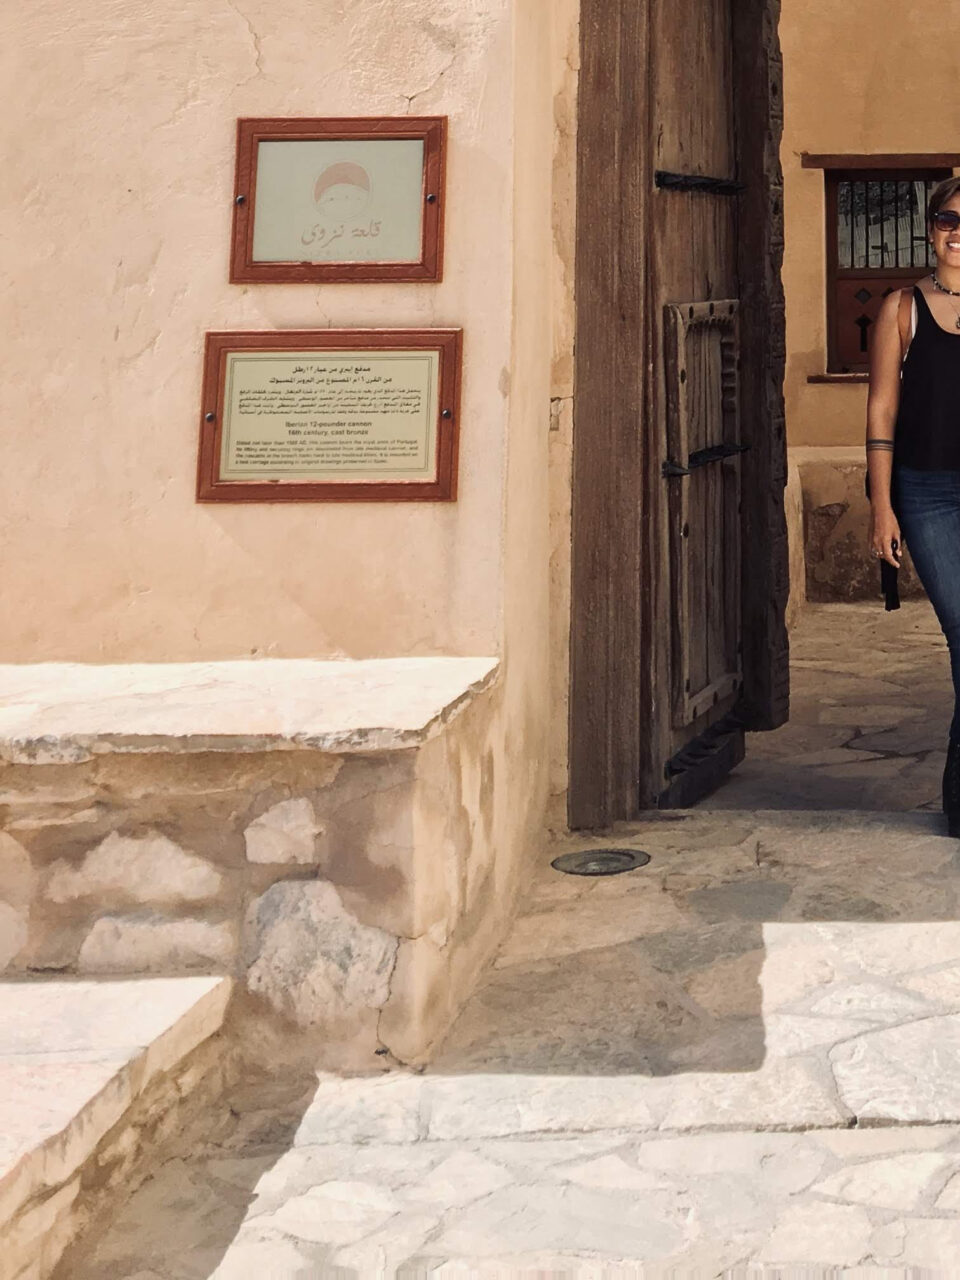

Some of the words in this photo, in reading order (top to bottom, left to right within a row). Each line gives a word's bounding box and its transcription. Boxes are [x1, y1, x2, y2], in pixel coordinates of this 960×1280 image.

[300, 223, 345, 249] نزوى
[351, 218, 382, 238] قلعة
[354, 366, 371, 375] مدفع
